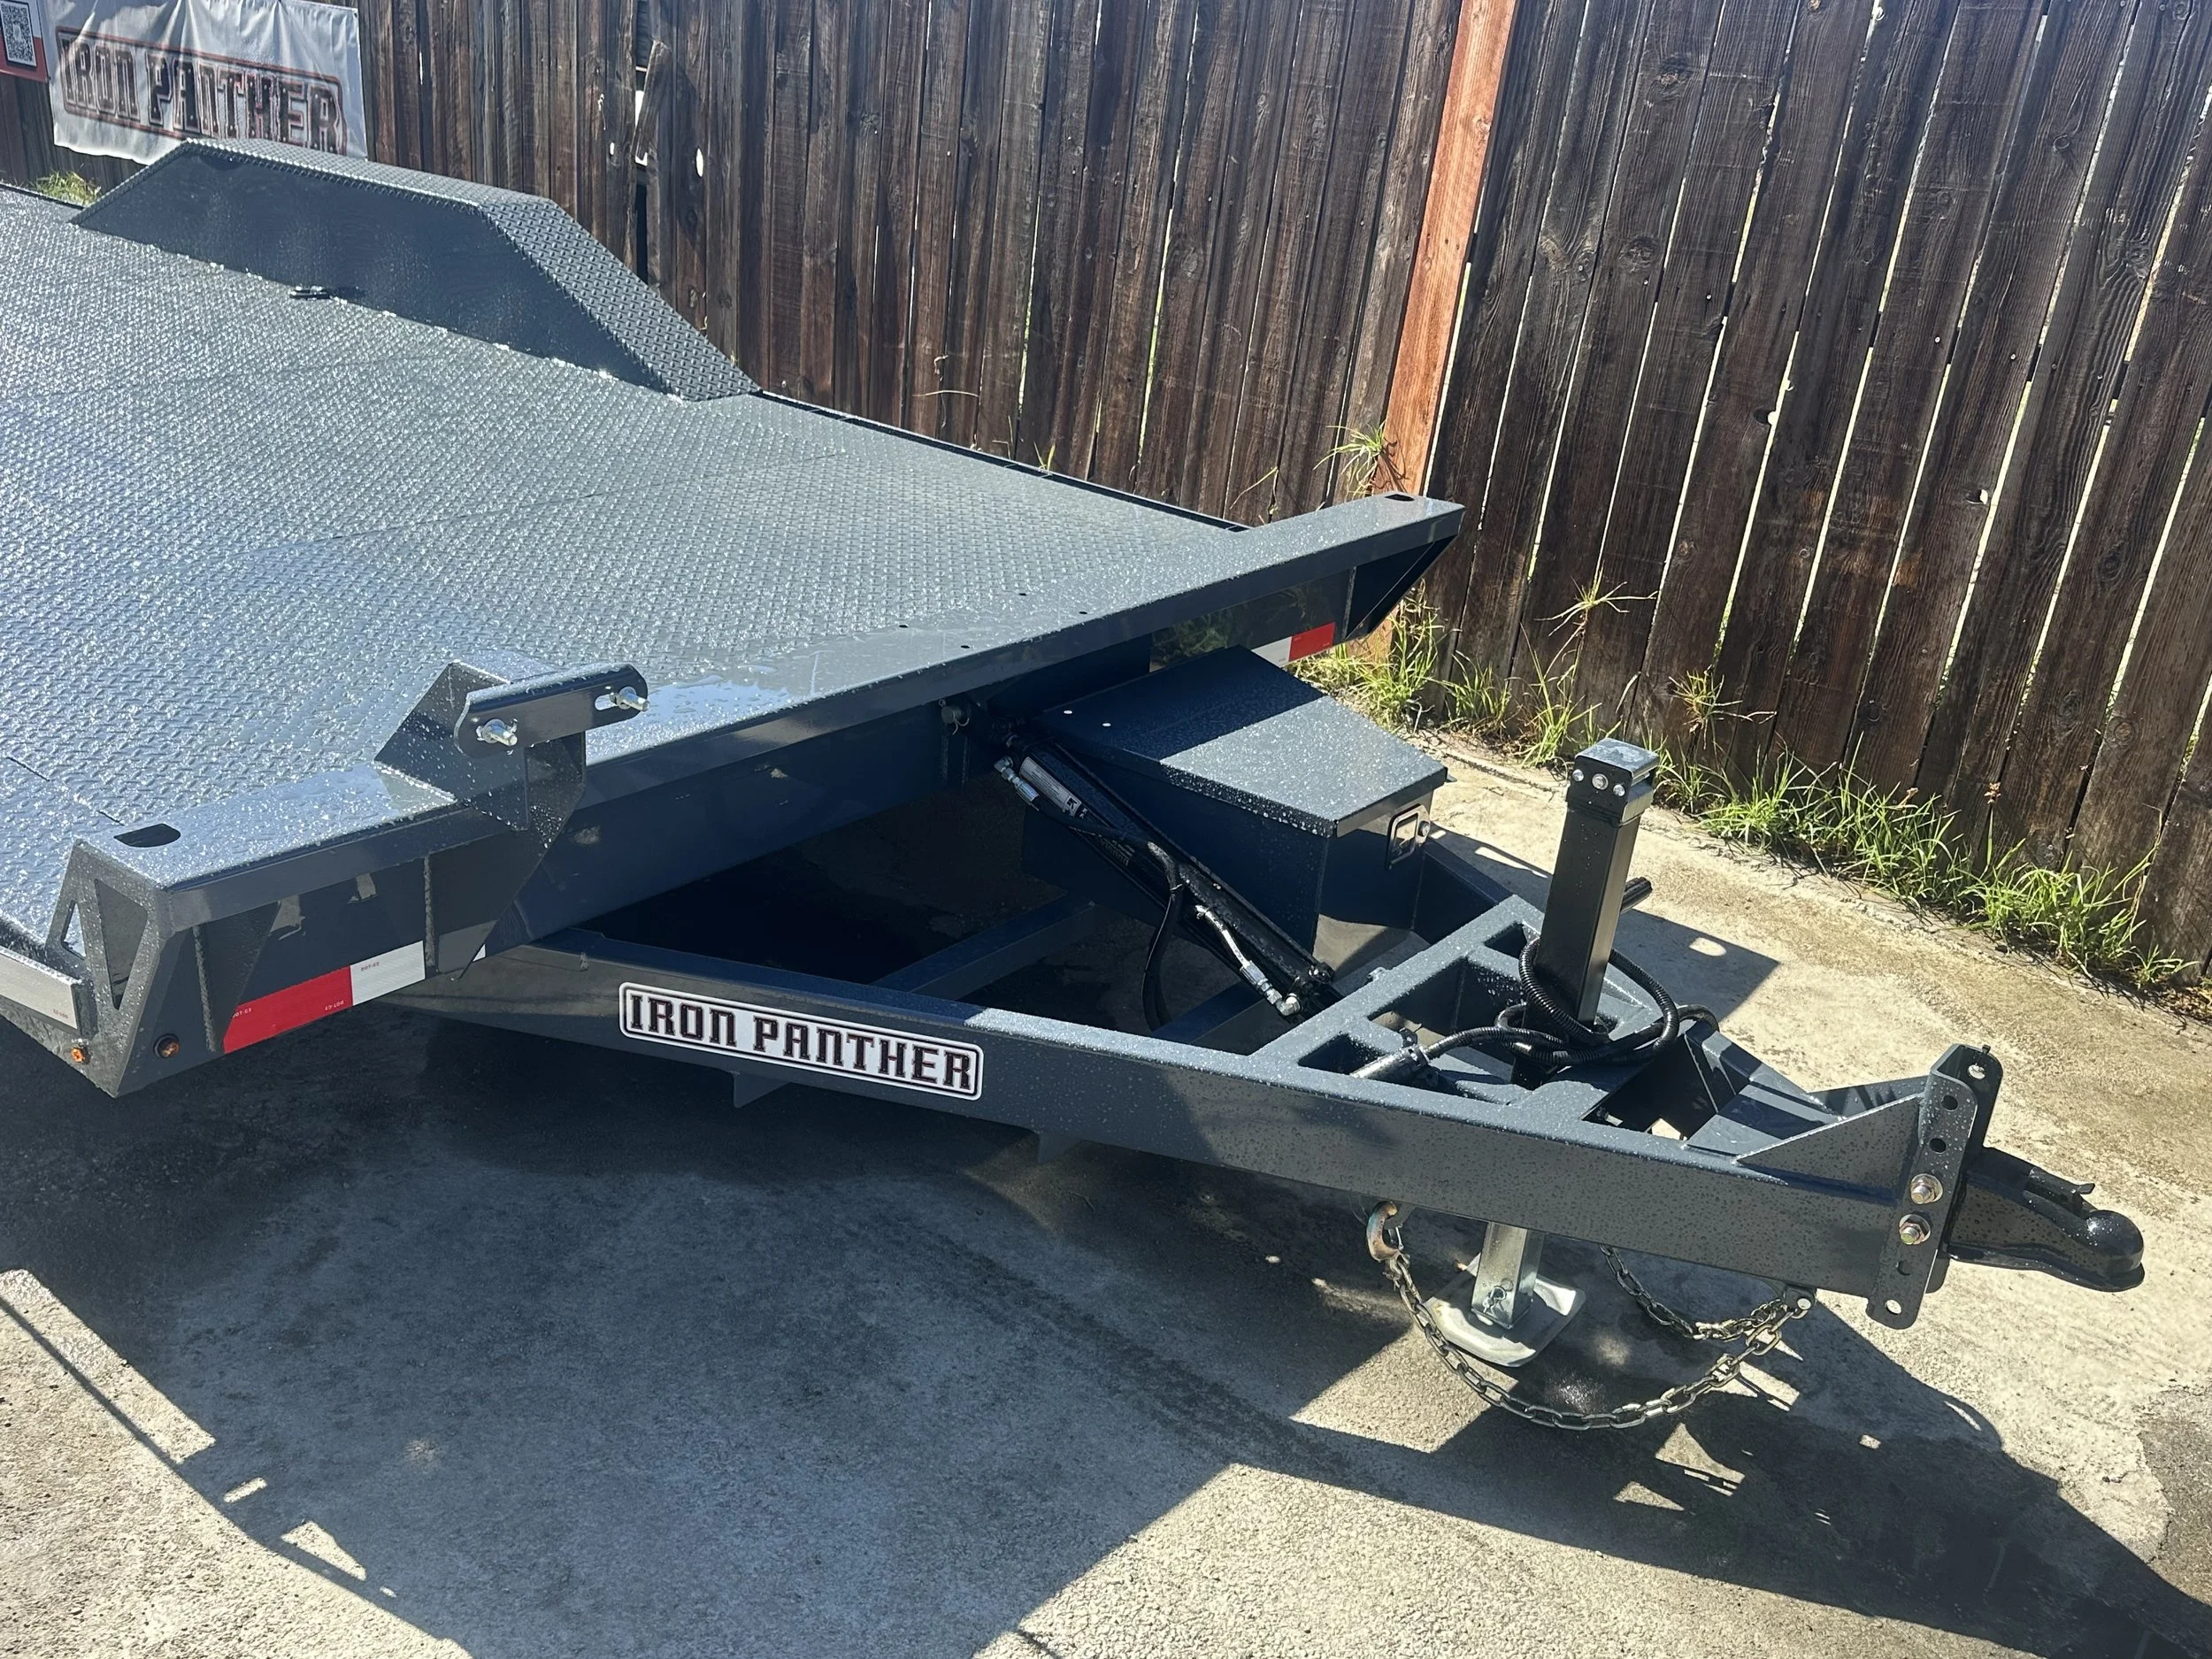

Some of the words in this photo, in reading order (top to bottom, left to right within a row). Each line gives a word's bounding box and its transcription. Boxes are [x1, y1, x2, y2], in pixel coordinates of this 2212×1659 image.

[60, 37, 140, 121] IRON
[145, 50, 347, 155] PANTHER
[630, 995, 736, 1048] IRON
[753, 1016, 972, 1090] PANTHER
